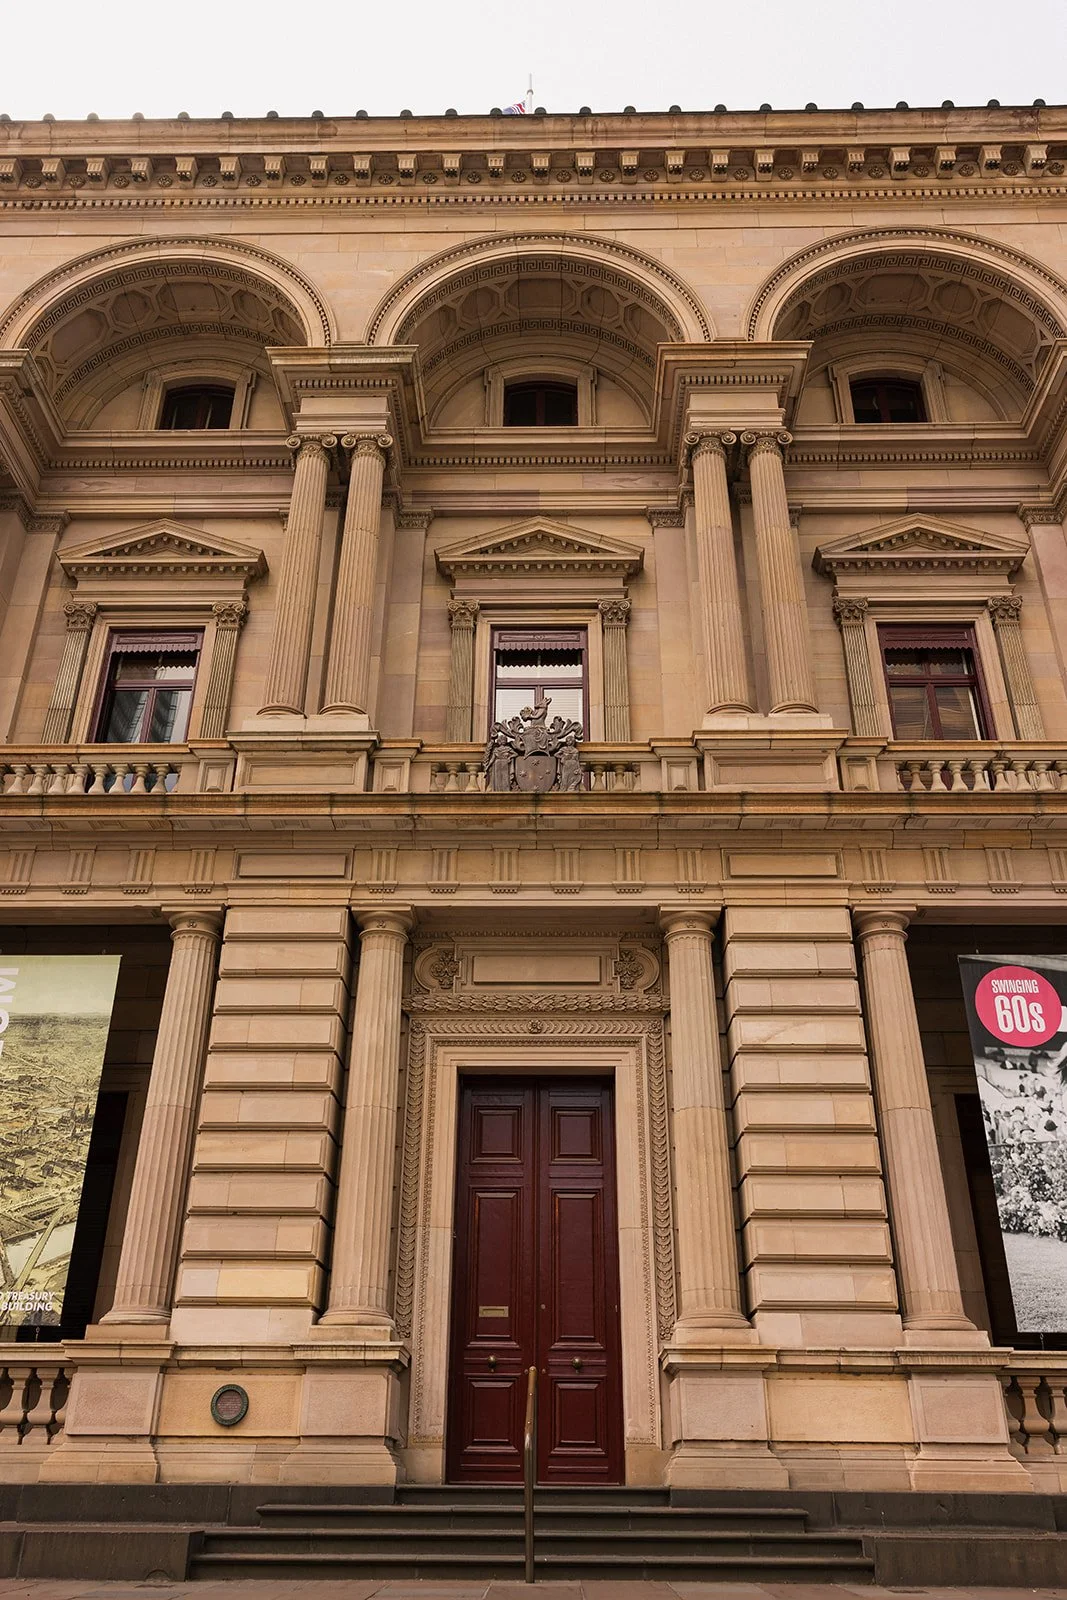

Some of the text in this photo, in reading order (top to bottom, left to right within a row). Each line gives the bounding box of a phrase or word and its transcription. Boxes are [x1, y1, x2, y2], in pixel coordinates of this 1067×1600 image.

[991, 979, 1040, 994] SWINGING
[994, 995, 1046, 1033] 60s
[7, 1291, 55, 1301] TREASURY
[2, 1301, 53, 1311] BUILDING
